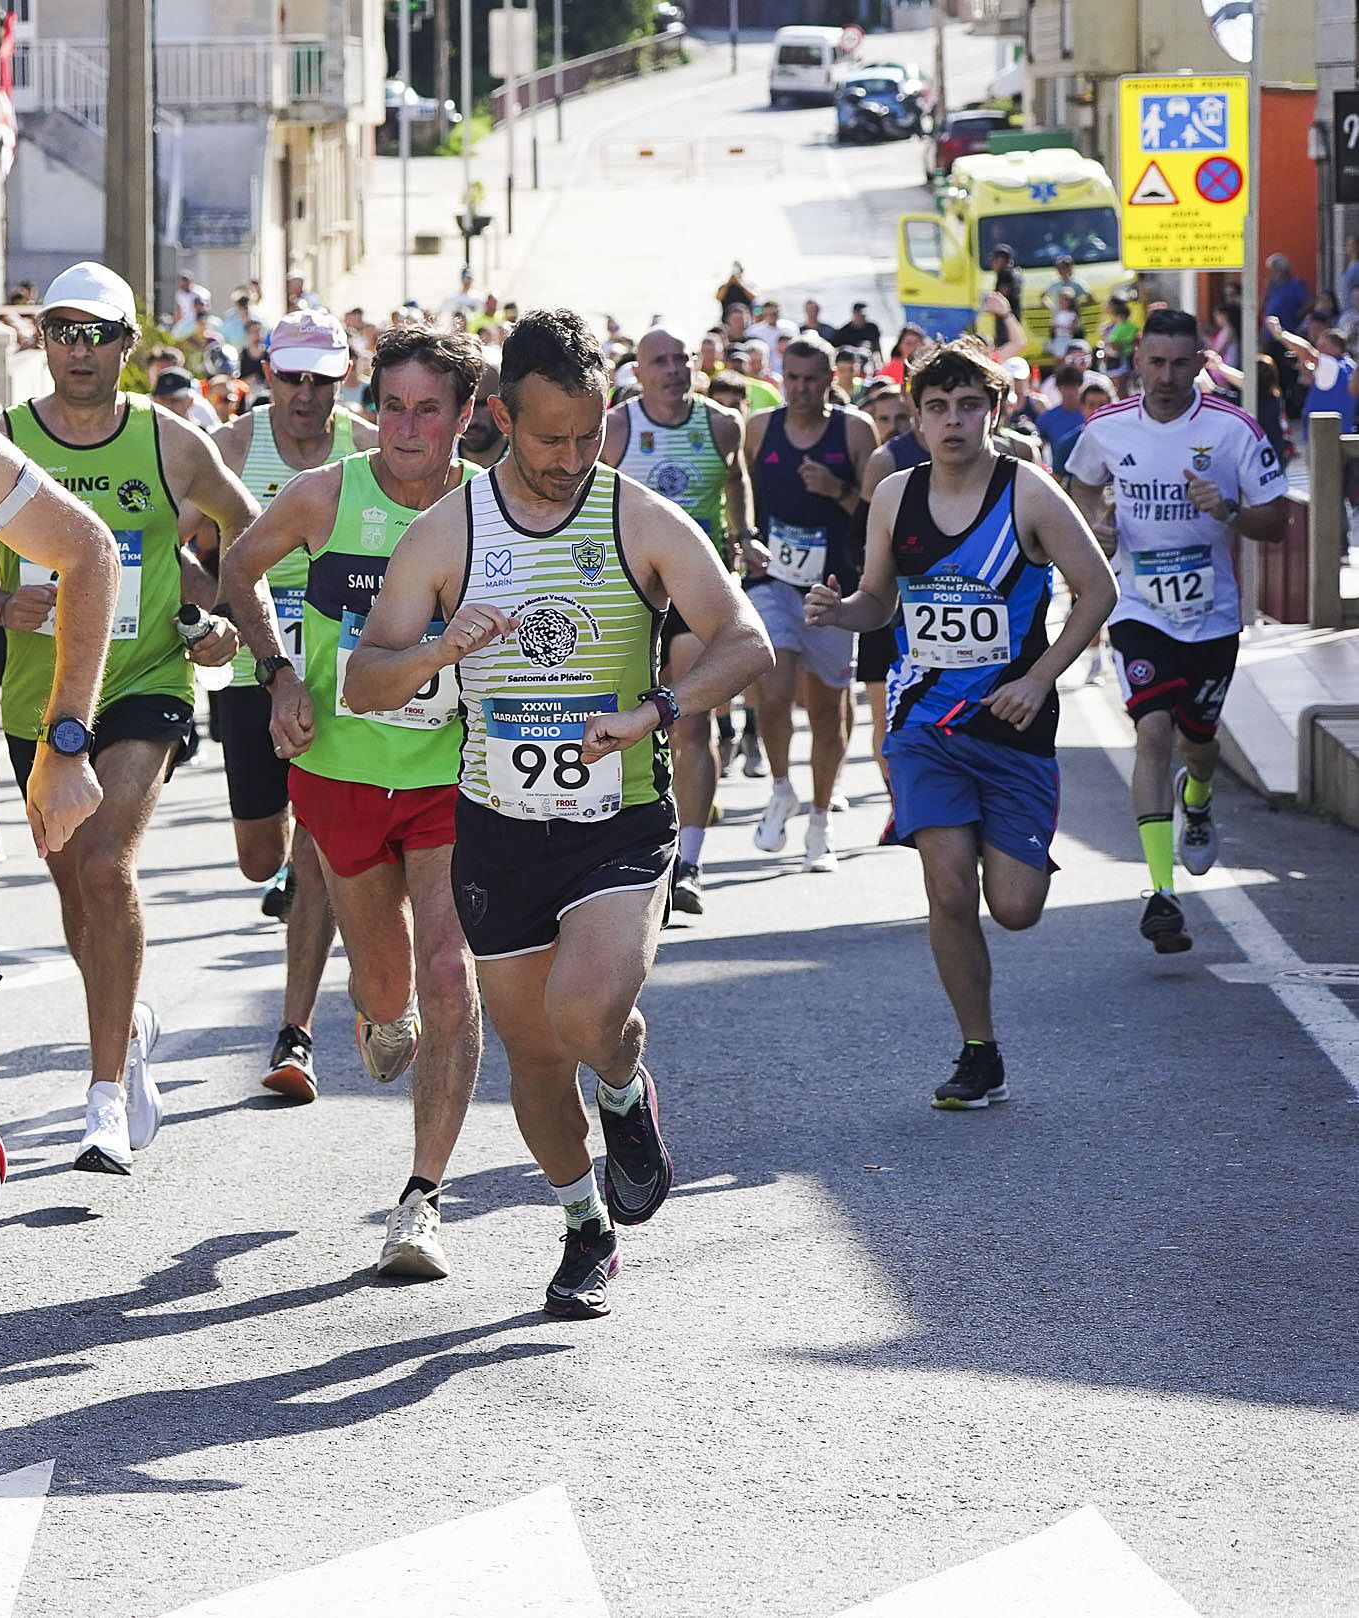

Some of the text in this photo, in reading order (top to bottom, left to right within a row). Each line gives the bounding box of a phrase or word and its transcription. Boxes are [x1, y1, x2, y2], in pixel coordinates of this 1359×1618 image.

[1119, 478, 1190, 501] Emirat
[780, 542, 811, 570] 87
[348, 574, 374, 590] SAN
[485, 578, 513, 588] MARÍN
[1149, 572, 1204, 604] 112
[933, 593, 962, 602] POIO
[915, 605, 1000, 643] 250
[547, 673, 559, 682] de
[521, 702, 562, 711] XXXVII
[492, 712, 539, 723] MARATÓN
[520, 726, 561, 737] POIO
[512, 743, 591, 790] 98
